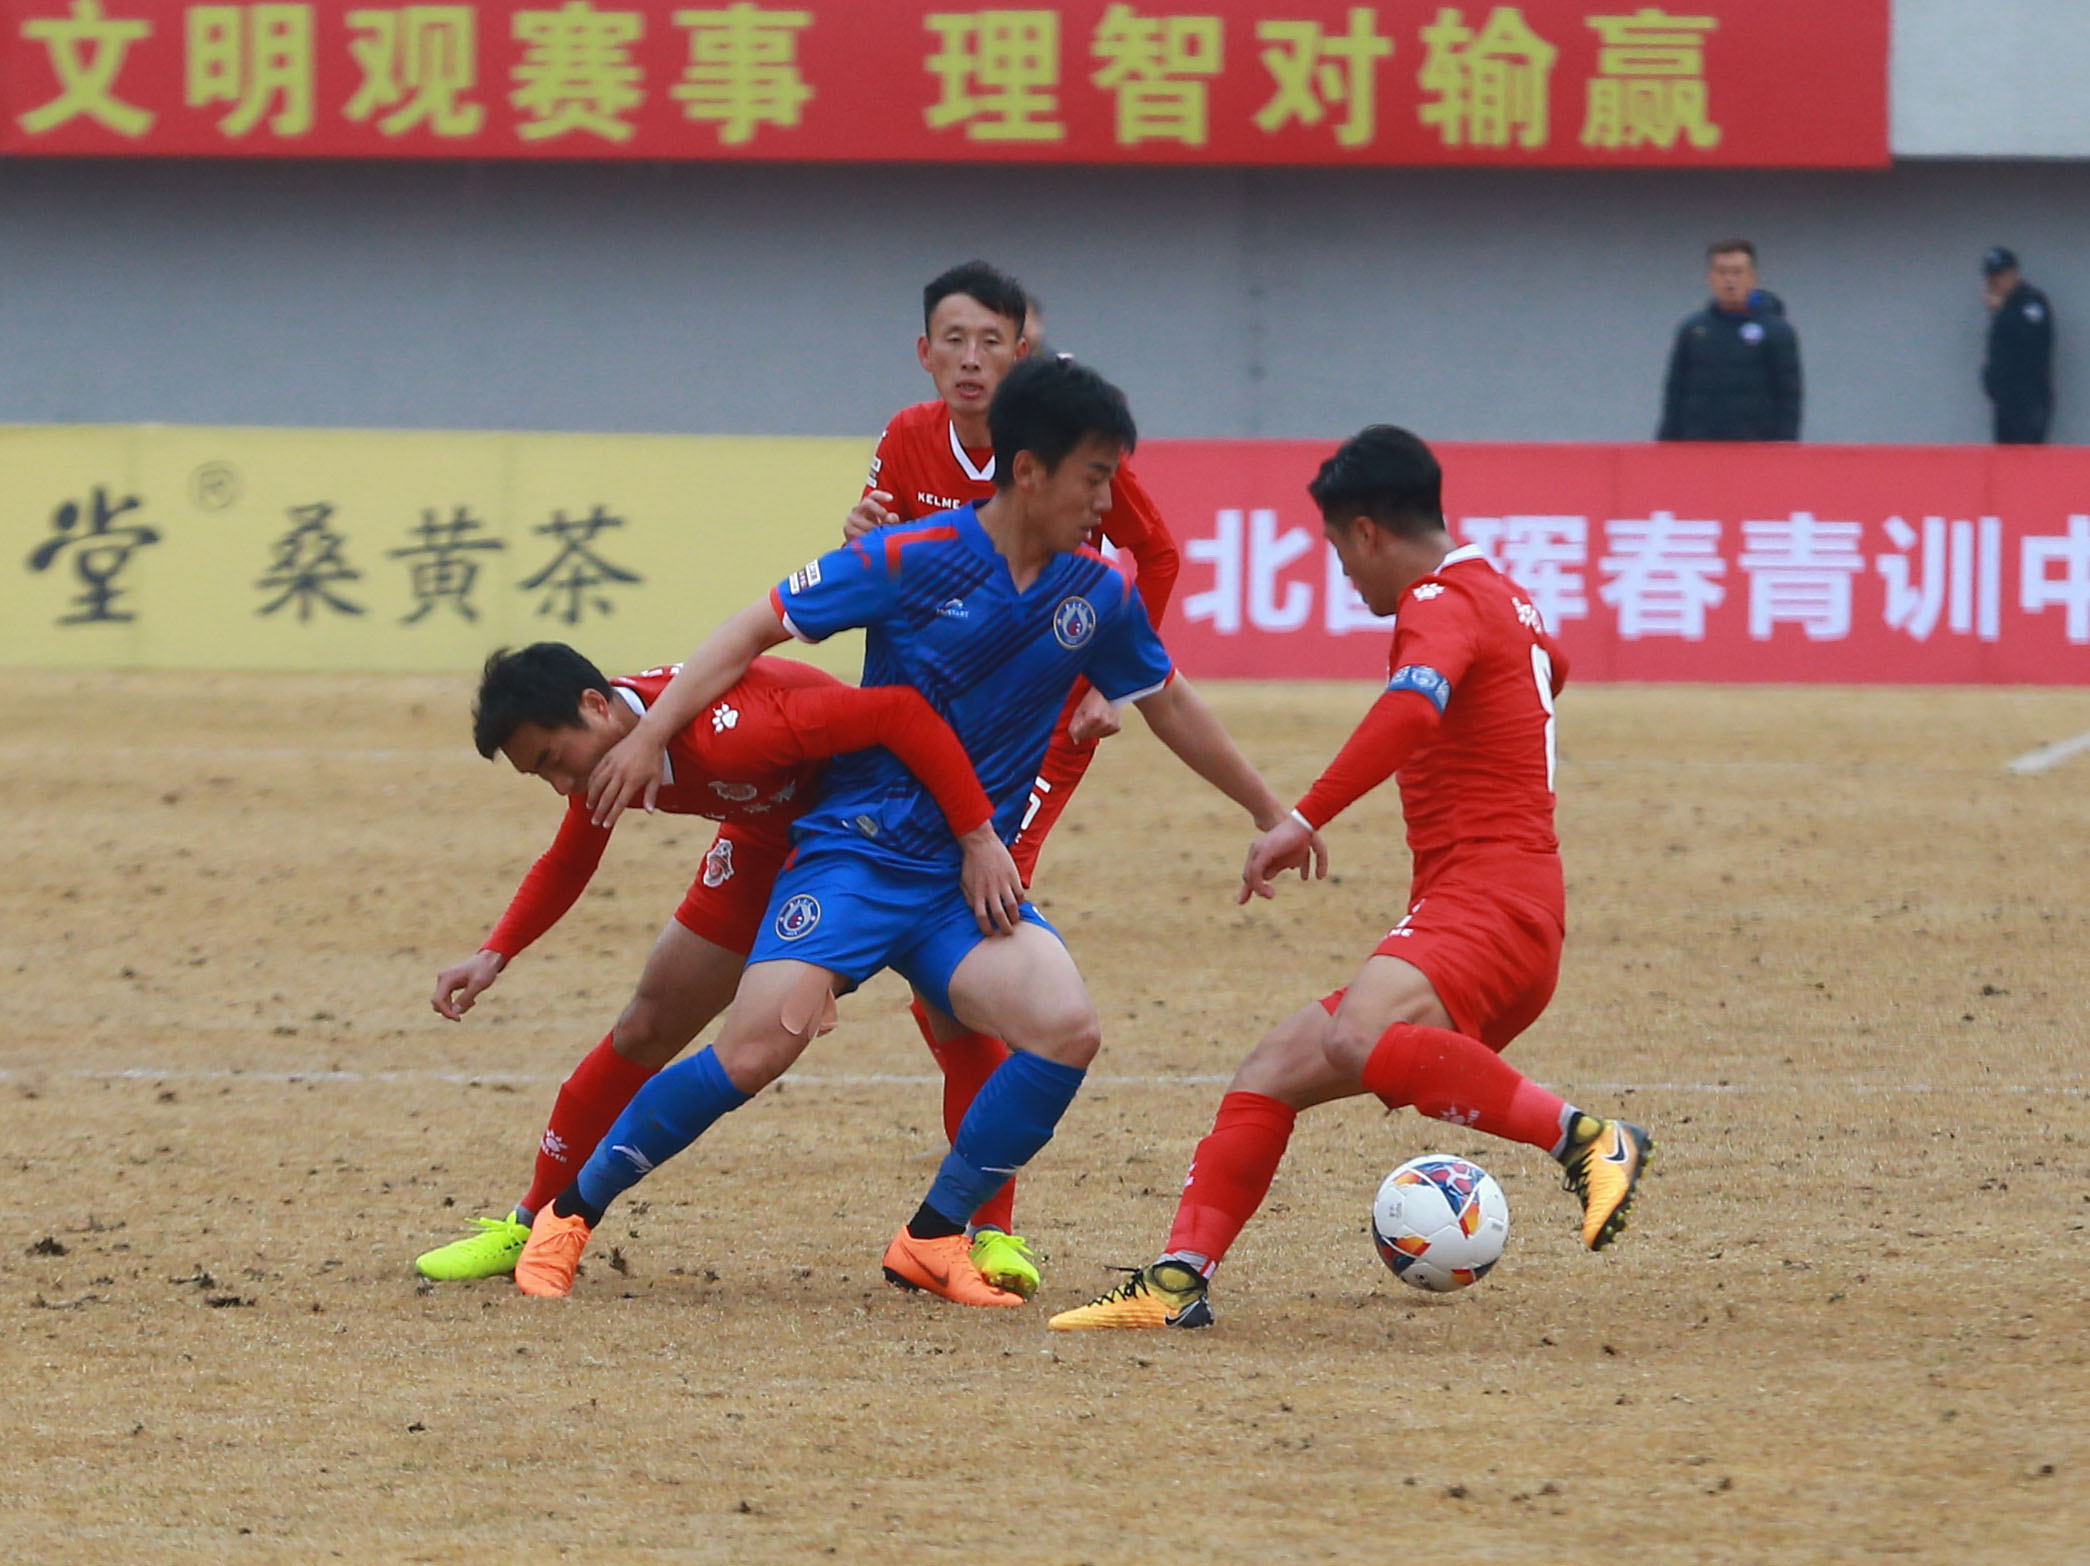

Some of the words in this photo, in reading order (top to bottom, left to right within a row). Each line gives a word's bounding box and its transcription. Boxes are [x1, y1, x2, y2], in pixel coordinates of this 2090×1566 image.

[18, 0, 815, 145] 文明观赛事
[923, 3, 1721, 149] 理智对输赢
[26, 486, 163, 627] 堂
[256, 501, 645, 627] 桑黄茶
[917, 491, 960, 510] KELME
